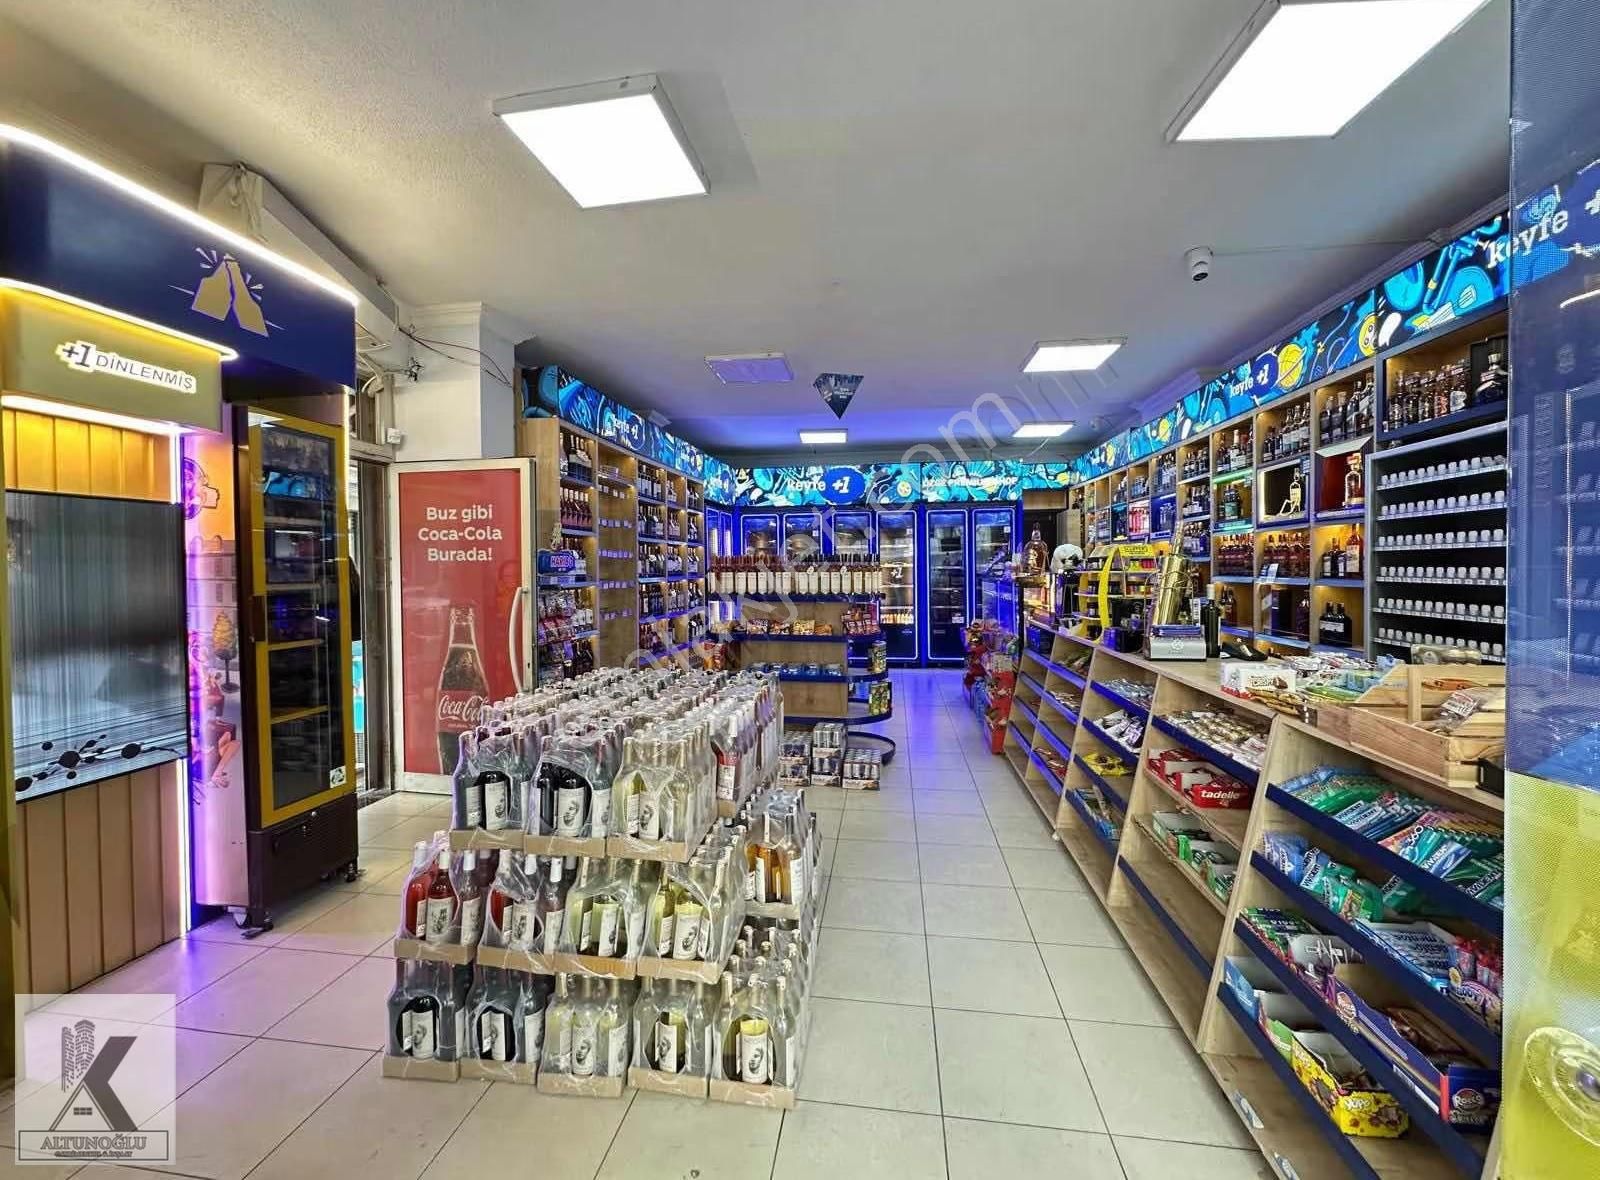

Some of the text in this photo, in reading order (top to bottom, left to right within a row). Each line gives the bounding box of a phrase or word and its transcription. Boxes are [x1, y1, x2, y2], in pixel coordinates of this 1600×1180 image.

[1484, 210, 1569, 269] keyfe
[62, 343, 91, 368] +1
[1229, 363, 1270, 397] keyfe +1
[832, 476, 850, 494] +1
[426, 504, 493, 523] Buz gibi
[418, 526, 503, 541] Coca-Cola
[428, 547, 493, 561] Burada!
[1201, 789, 1240, 799] tadelle
